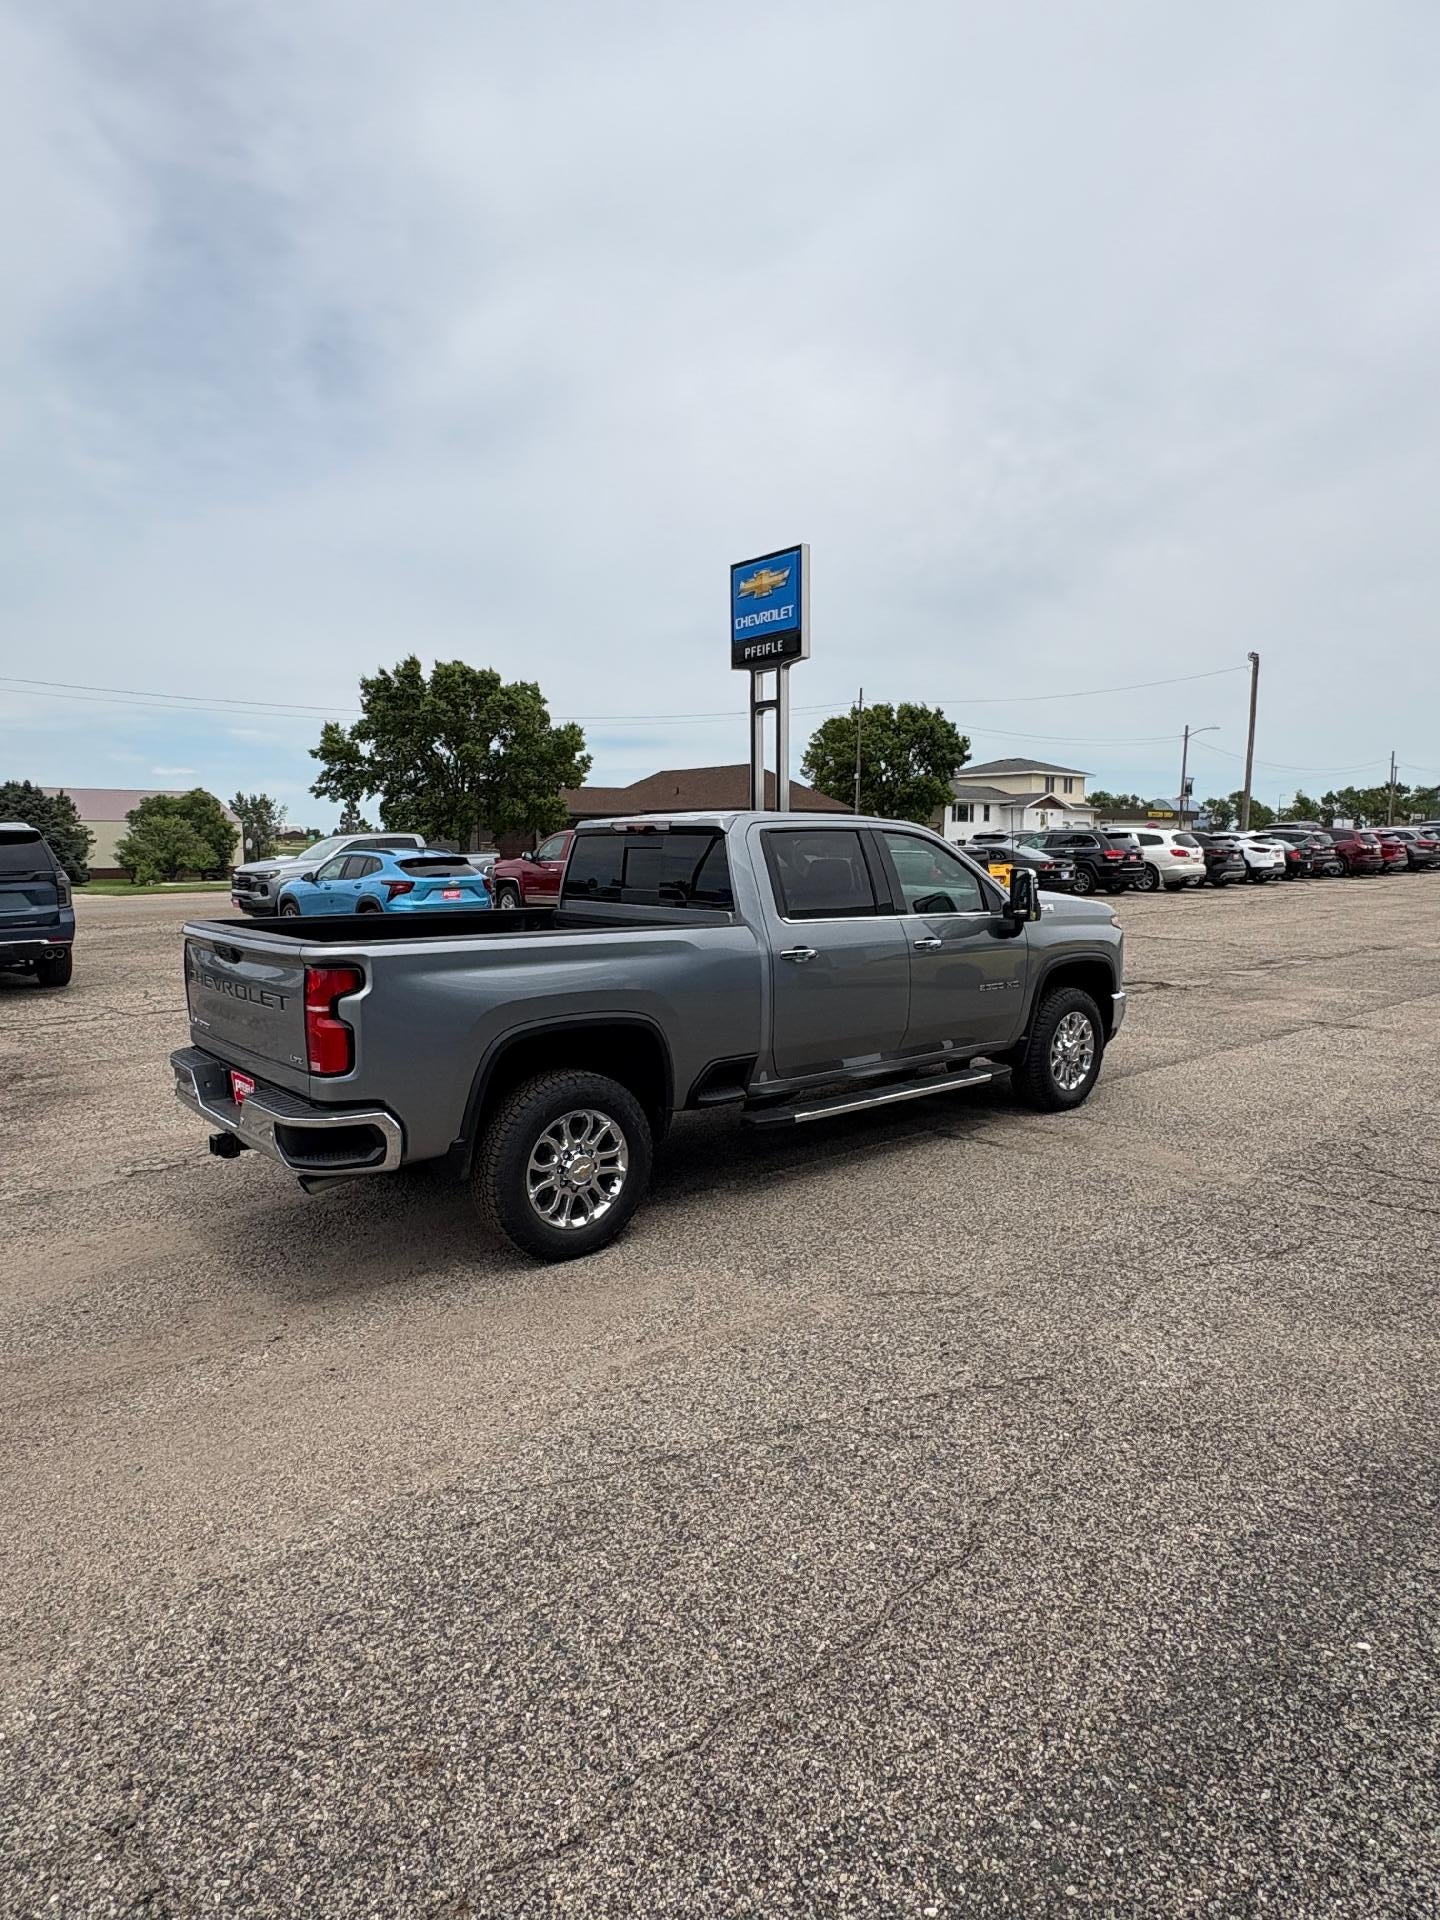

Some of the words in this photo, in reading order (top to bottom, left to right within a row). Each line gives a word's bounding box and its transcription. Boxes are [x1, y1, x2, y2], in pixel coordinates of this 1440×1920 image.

[735, 604, 794, 629] CHEVROLET
[744, 640, 784, 659] PFEIFLE
[188, 968, 290, 1011] CHEVROLET
